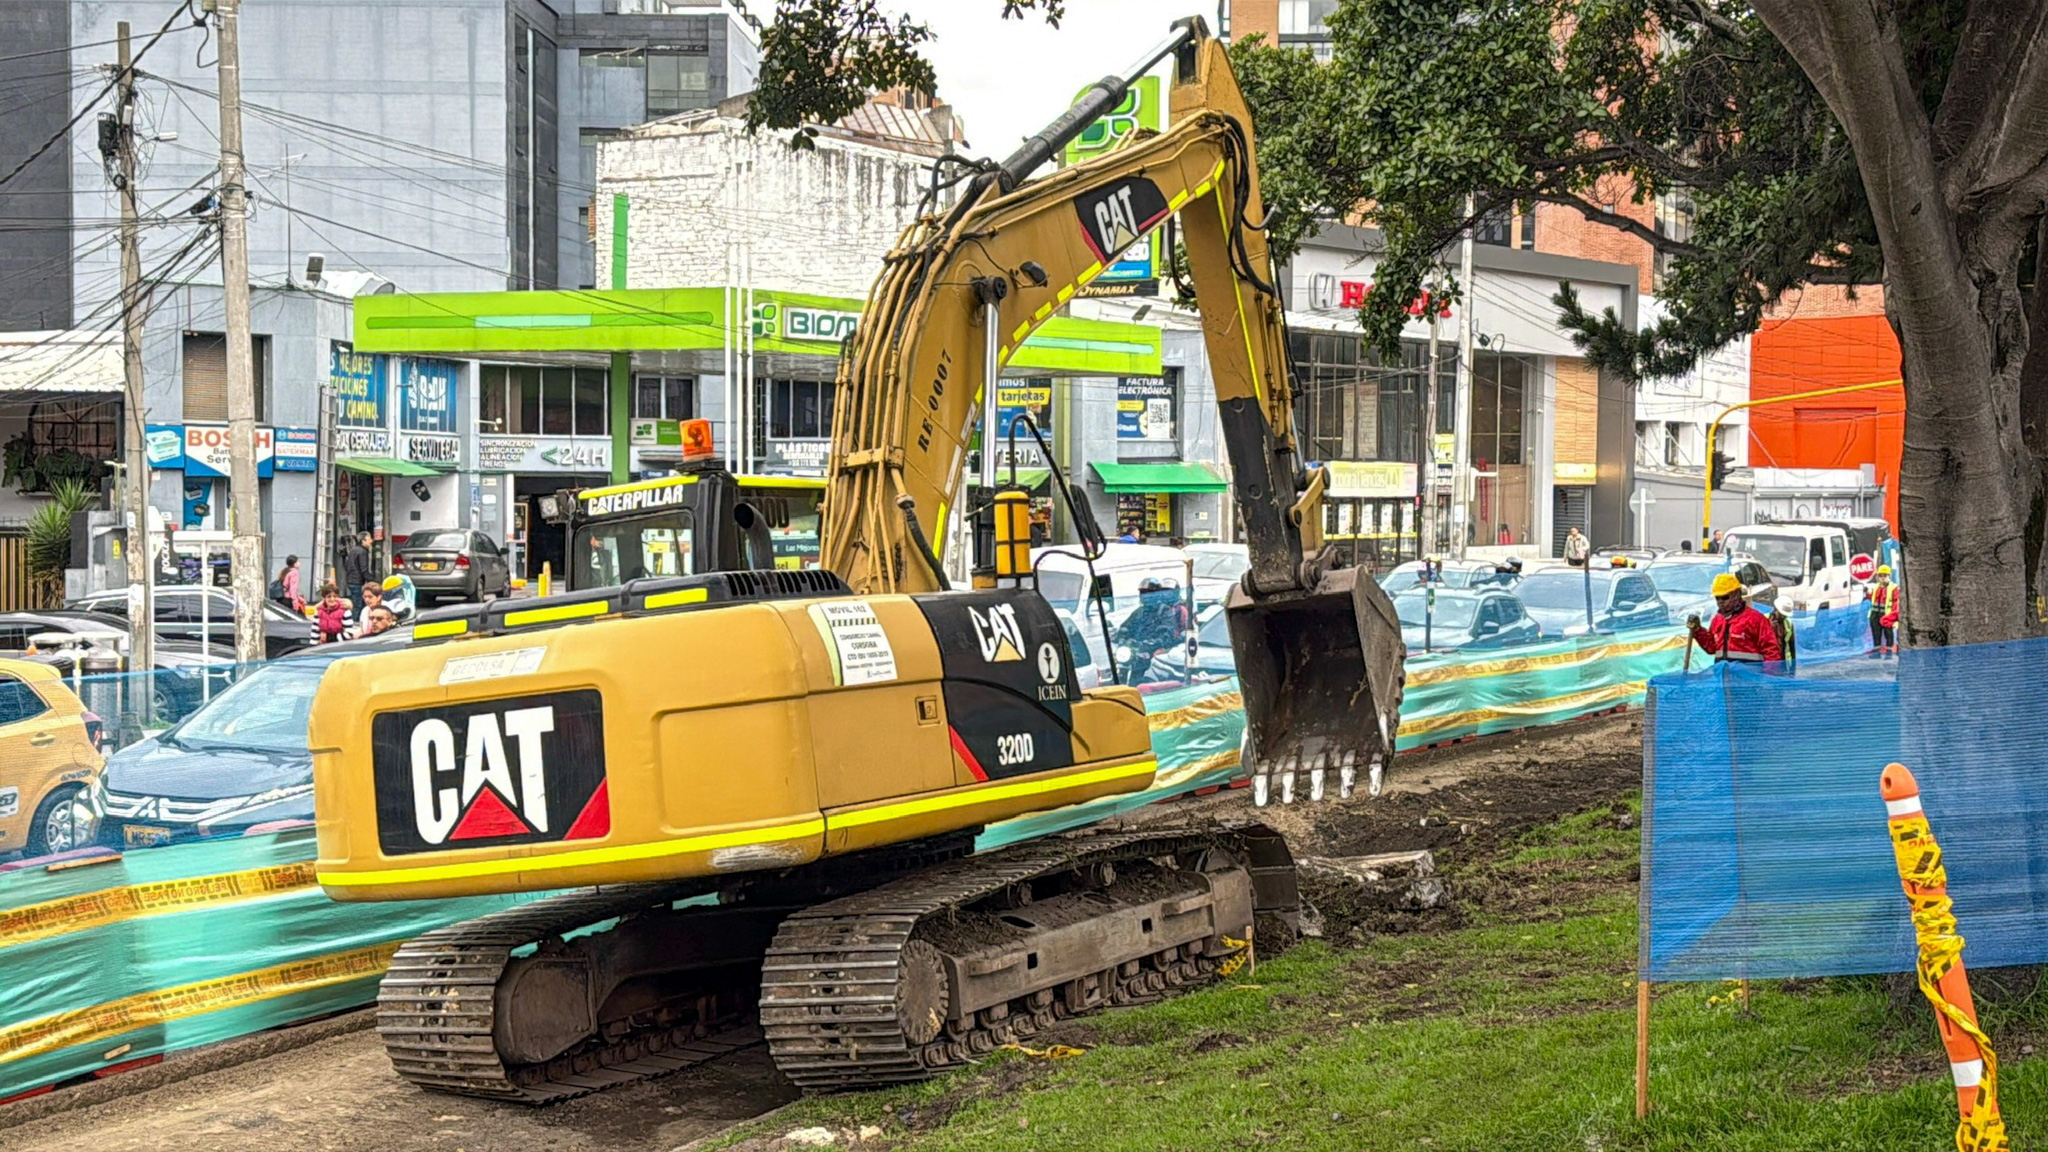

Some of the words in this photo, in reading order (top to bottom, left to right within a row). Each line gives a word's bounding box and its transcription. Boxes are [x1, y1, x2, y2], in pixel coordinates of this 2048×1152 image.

[1094, 184, 1140, 255] CAT
[1078, 283, 1139, 297] DYNAMAX
[927, 347, 952, 411] 0007
[1125, 377, 1165, 386] FACTURA
[1001, 390, 1045, 404] tarjetas
[480, 460, 507, 469] FRENOS
[587, 483, 684, 516] CATERPILLAR
[1850, 562, 1874, 574] PARE
[966, 602, 1027, 663] CAT
[1037, 684, 1067, 701] ICEIN
[996, 732, 1035, 766] 320D
[410, 705, 555, 845] CAT
